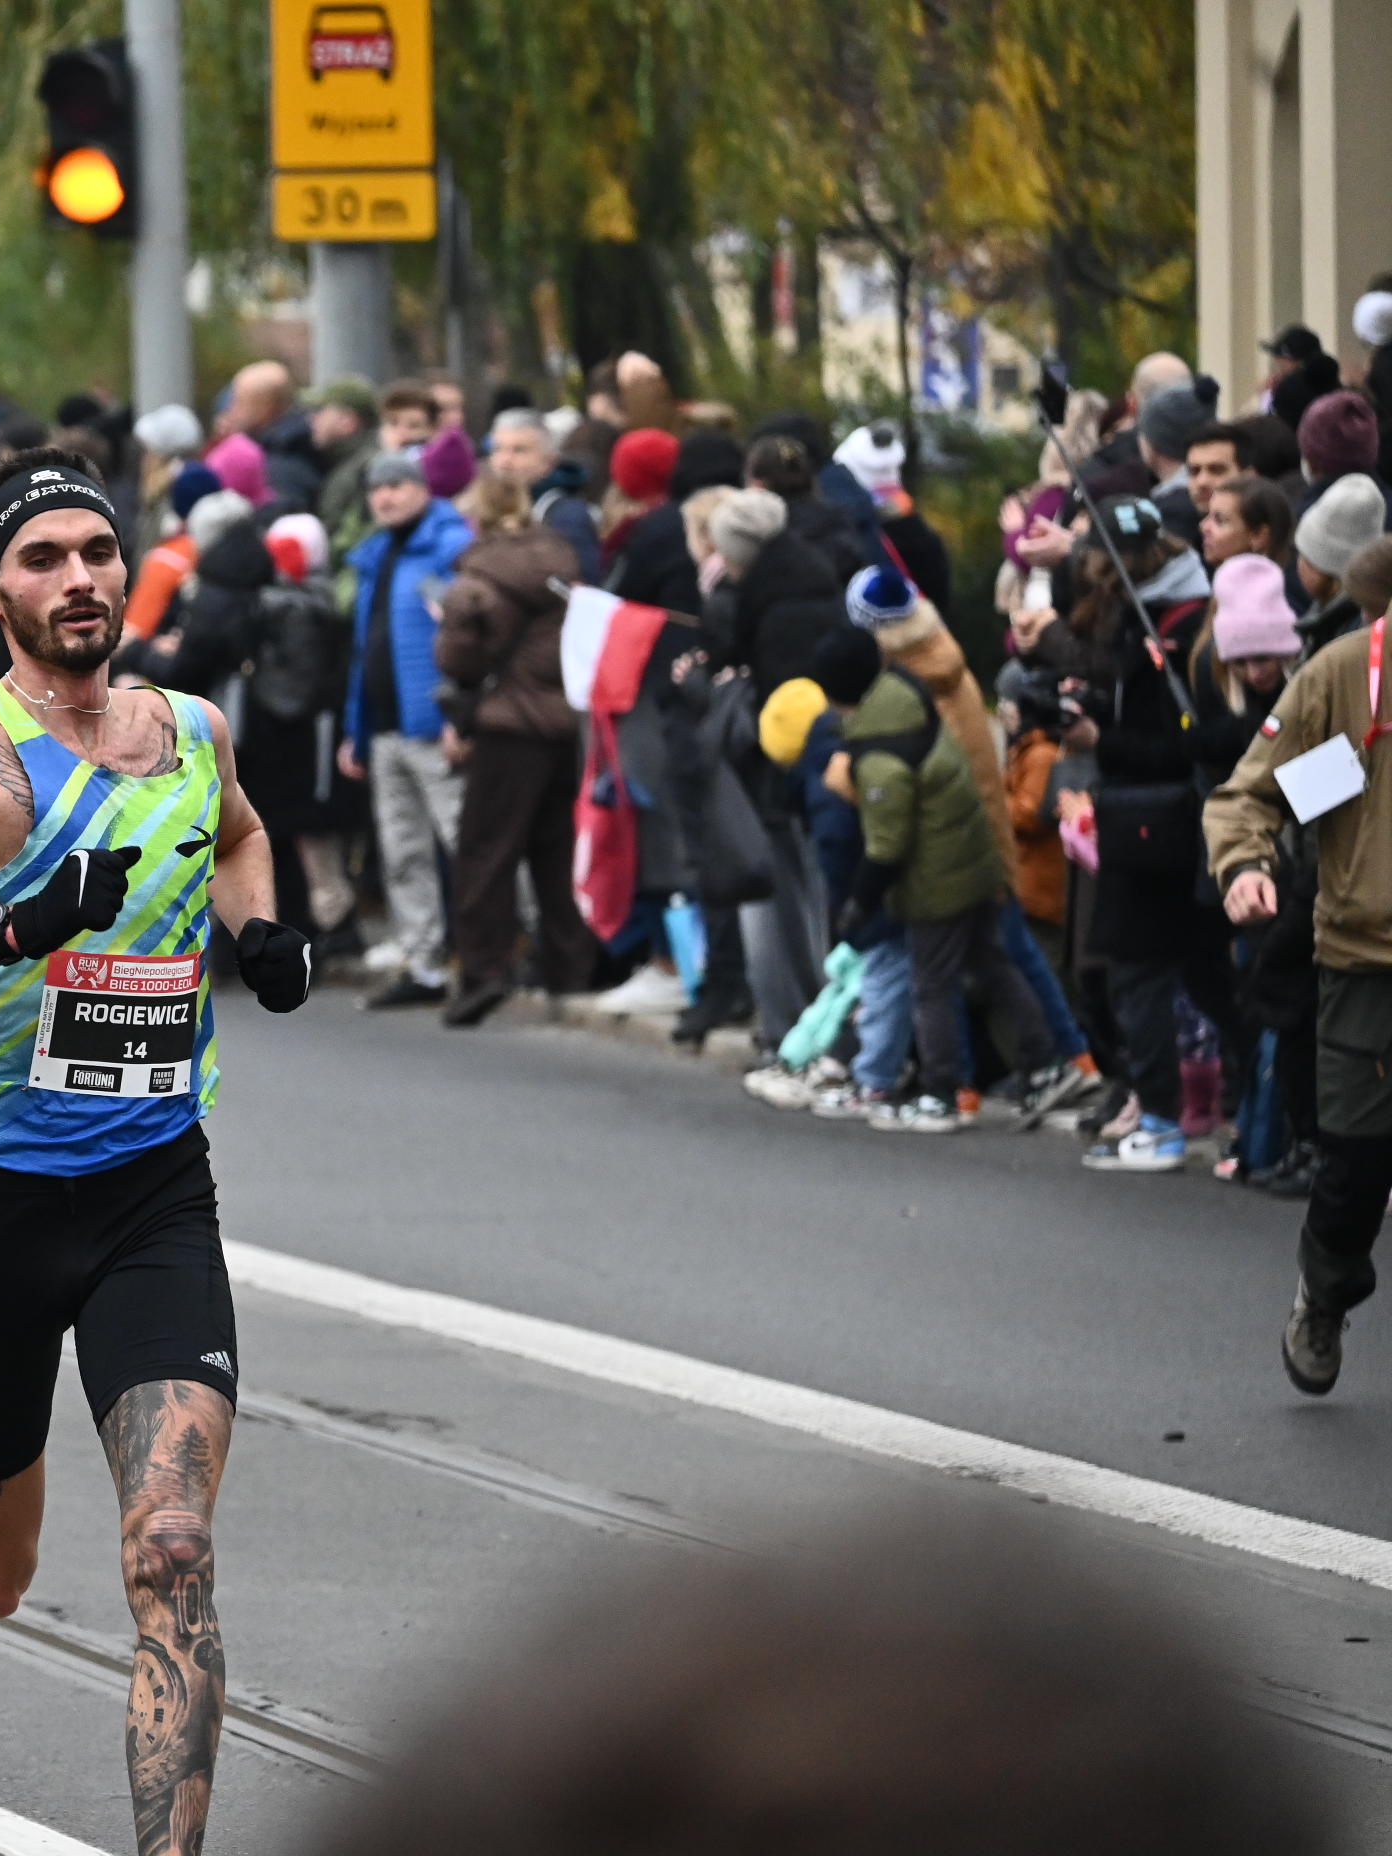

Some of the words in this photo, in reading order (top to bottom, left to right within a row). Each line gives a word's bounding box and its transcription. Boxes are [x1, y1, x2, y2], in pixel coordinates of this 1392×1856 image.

[311, 38, 391, 69] STRAŻ
[302, 186, 361, 225] 30
[369, 197, 408, 223] m
[78, 958, 99, 968] RUN
[109, 979, 139, 991] BIEG
[74, 1002, 190, 1026] ROGIEWICZ
[123, 1041, 148, 1059] 14
[72, 1069, 115, 1089] FORTUNA
[200, 1354, 235, 1379] adidas
